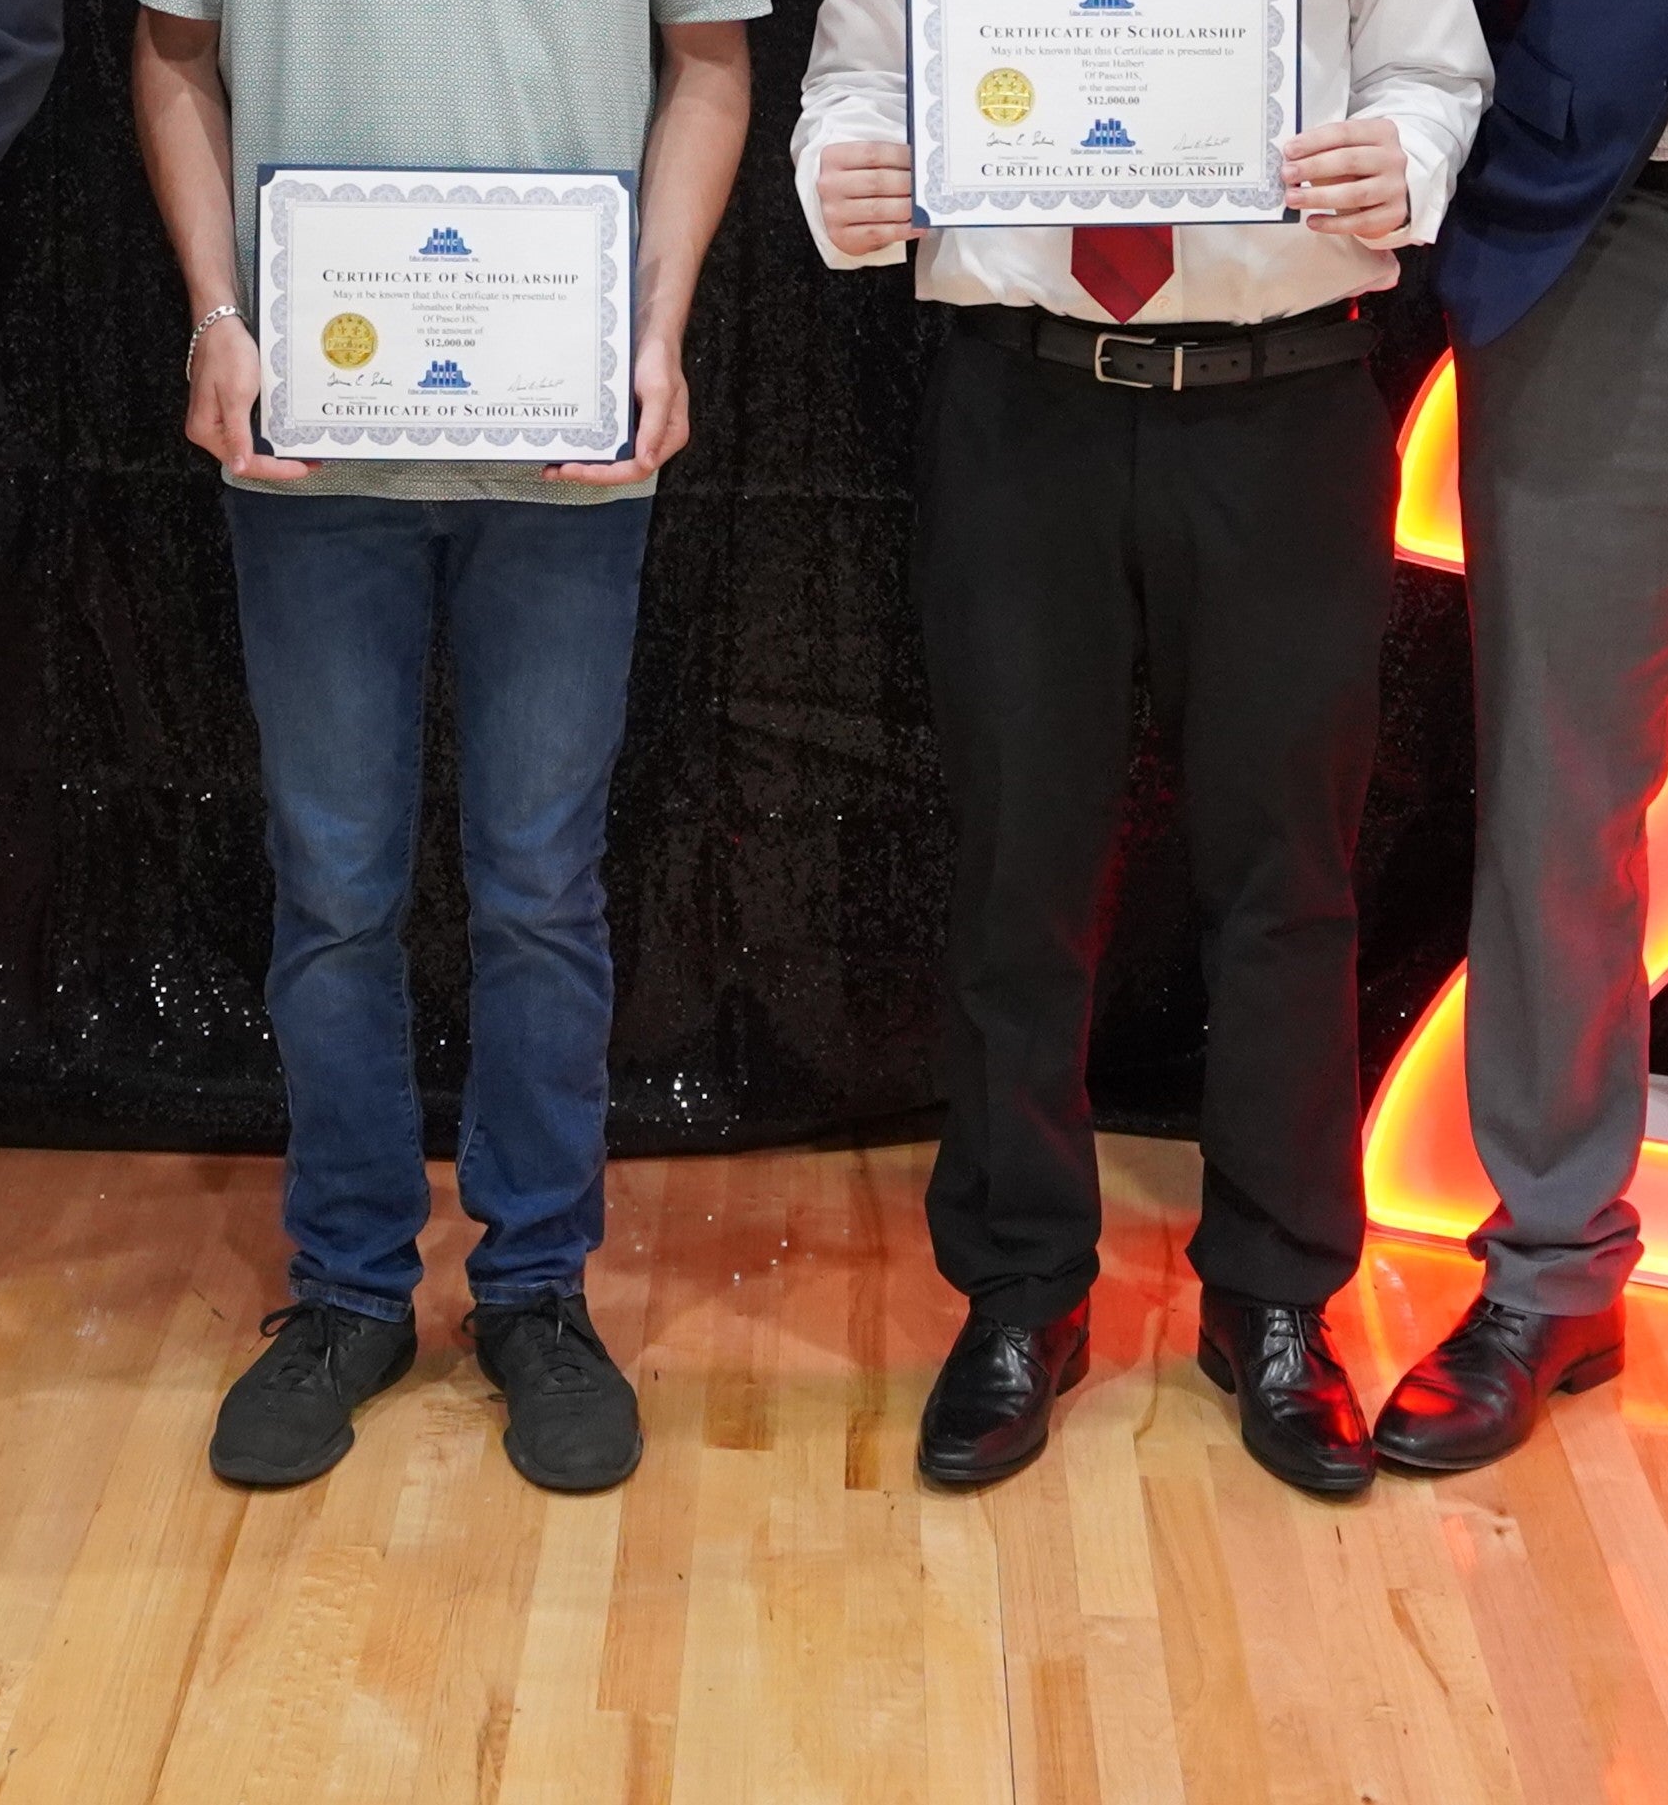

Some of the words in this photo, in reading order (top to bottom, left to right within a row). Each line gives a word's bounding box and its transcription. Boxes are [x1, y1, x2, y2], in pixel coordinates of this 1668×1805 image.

[980, 25, 1093, 38] CERTIFICATE
[1100, 27, 1121, 38] OF
[1127, 25, 1246, 38] SCHOLARSHIP
[991, 46, 1012, 57] May
[1015, 46, 1022, 56] it
[1025, 46, 1036, 56] be
[1039, 46, 1071, 56] known
[1074, 46, 1091, 56] that
[1094, 46, 1111, 56] this
[1114, 46, 1164, 56] Certificate
[1167, 46, 1175, 56] is
[1177, 46, 1222, 57] presented
[1225, 46, 1234, 56] to
[1084, 71, 1096, 79] Of
[1098, 71, 1123, 79] Pasco
[1078, 84, 1087, 92] in
[1089, 83, 1102, 92] the
[1104, 84, 1137, 92] amount
[1139, 83, 1148, 92] of
[1087, 96, 1140, 105] $12,000.00
[981, 163, 1094, 176] CERTIFICATE
[1101, 166, 1122, 176] OF
[1128, 163, 1244, 177] SCHOLARSHIP
[322, 269, 432, 283] CERTIFICATE
[438, 272, 458, 283] OF
[464, 270, 579, 285] SCHOLARSHIP
[333, 290, 353, 300] May
[356, 290, 363, 299] it
[365, 290, 376, 299] be
[379, 290, 410, 299] known
[412, 290, 430, 299] that
[432, 290, 449, 300] this
[451, 290, 499, 301] Certificate
[502, 292, 510, 301] is
[512, 292, 555, 303] presented
[558, 292, 567, 301] to
[423, 315, 434, 323] Of
[436, 315, 459, 323] Pasco
[442, 327, 473, 335] amount
[475, 327, 483, 335] of
[425, 339, 476, 347] $12,000.00
[322, 402, 432, 416] CERTIFICATE
[437, 404, 458, 416] OF
[464, 403, 579, 417] SCHOLARSHIP
